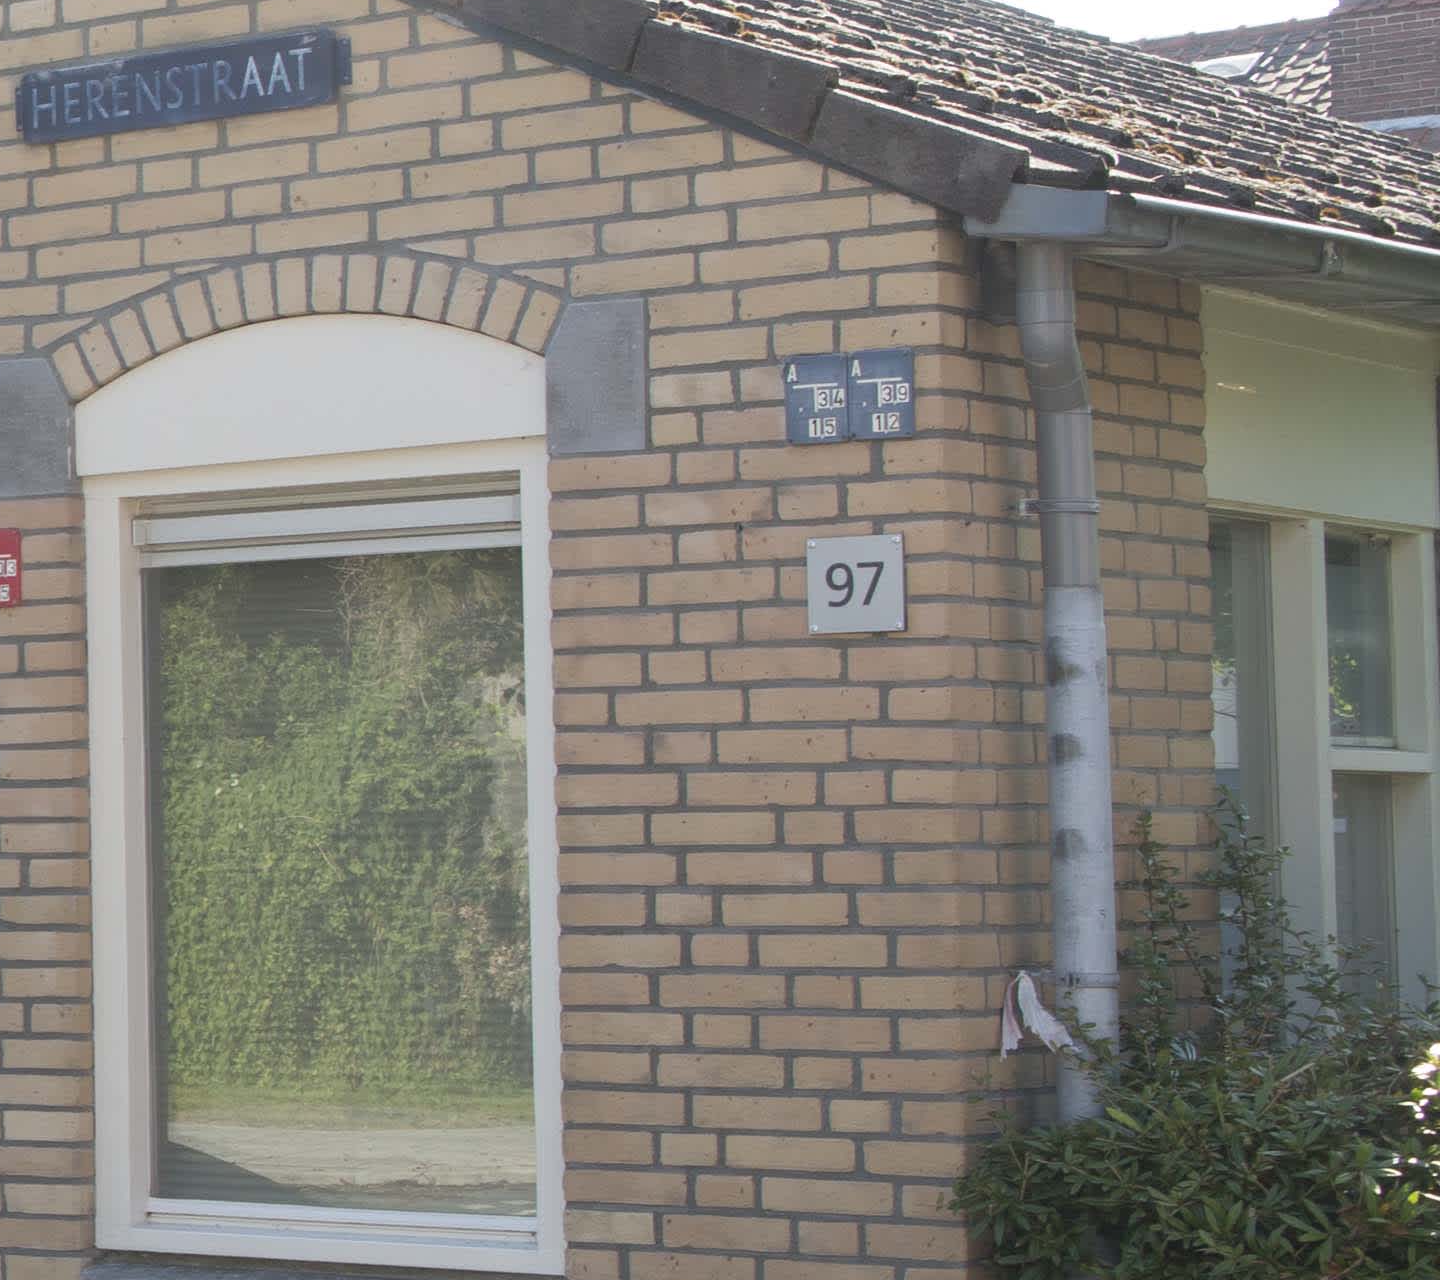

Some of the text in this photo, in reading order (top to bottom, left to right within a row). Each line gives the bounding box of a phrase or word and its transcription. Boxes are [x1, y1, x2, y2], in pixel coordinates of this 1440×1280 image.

[31, 46, 313, 129] HERENSTRAAT
[786, 364, 798, 383] A
[851, 359, 862, 377] A
[824, 561, 885, 608] 97
